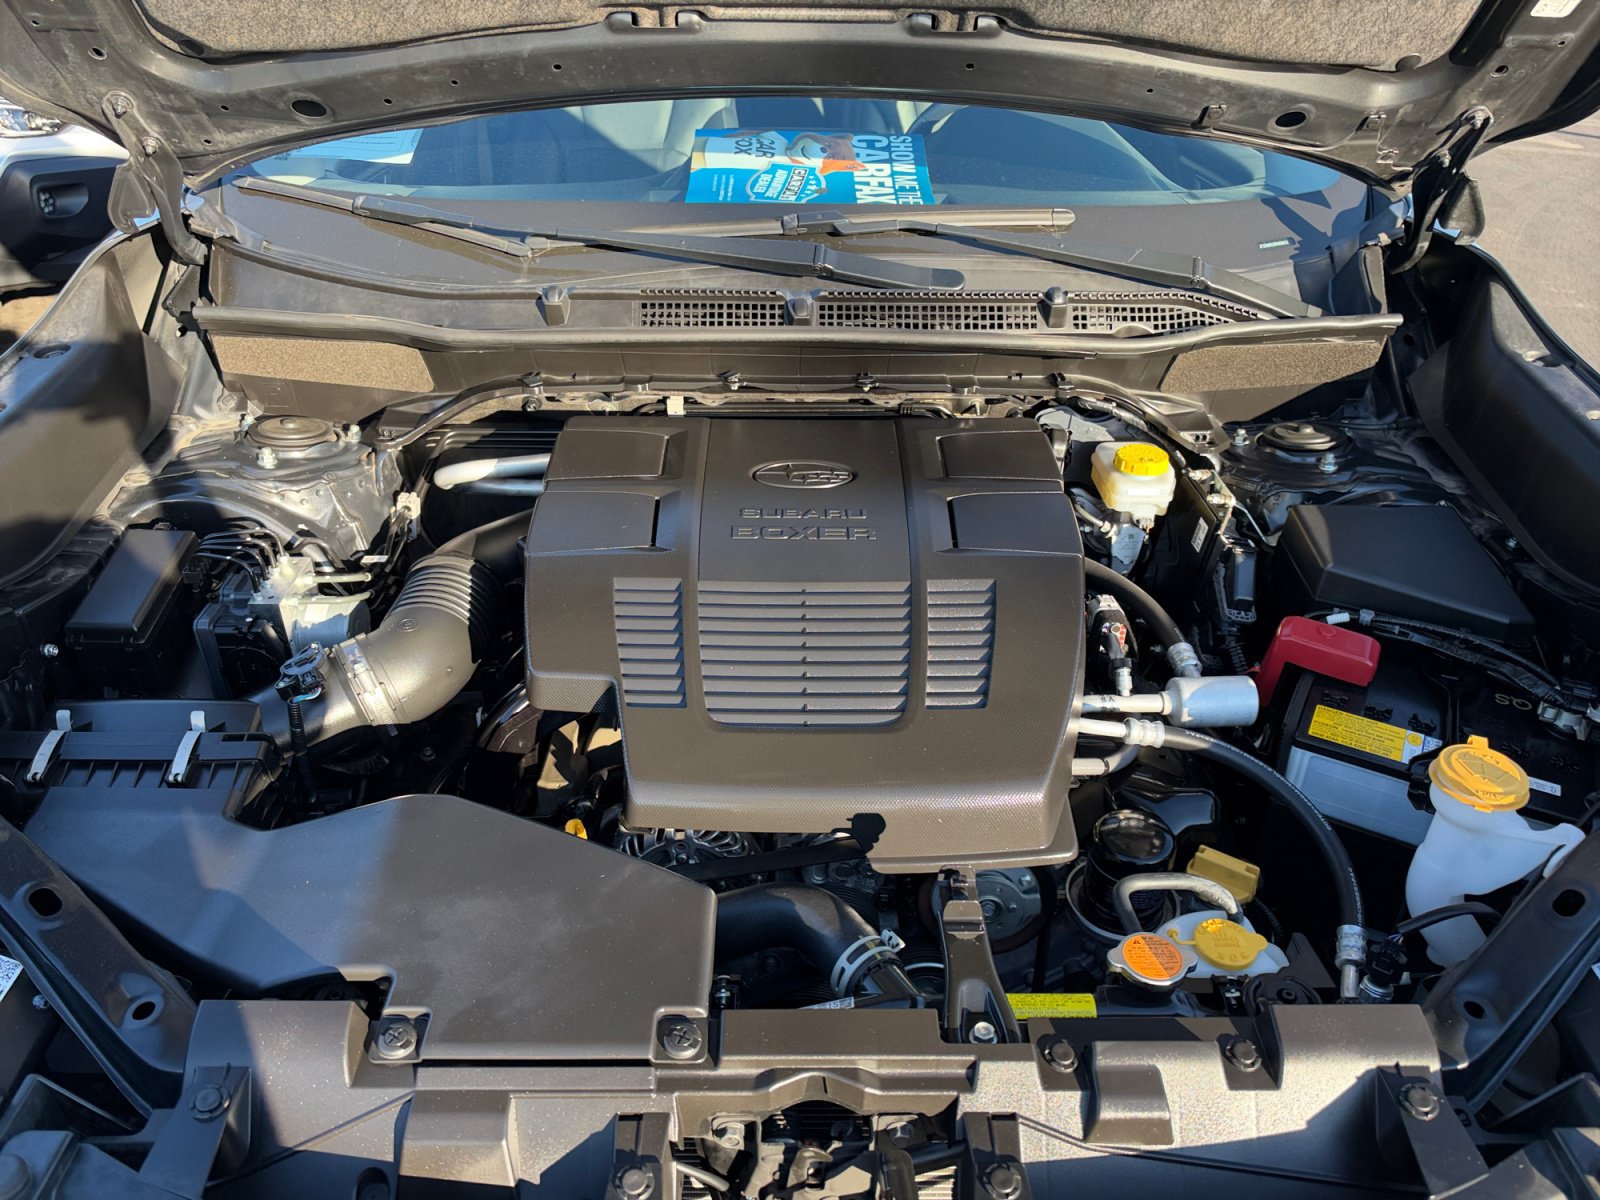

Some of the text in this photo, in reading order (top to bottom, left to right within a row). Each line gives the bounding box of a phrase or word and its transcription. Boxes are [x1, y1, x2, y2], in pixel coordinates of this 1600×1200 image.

[755, 138, 776, 159] CAR
[851, 134, 897, 205] CARFAX
[890, 135, 923, 205] SHOW ME THE
[780, 168, 808, 200] CARFAX
[739, 508, 867, 519] SUBARU
[731, 526, 877, 540] BOXER
